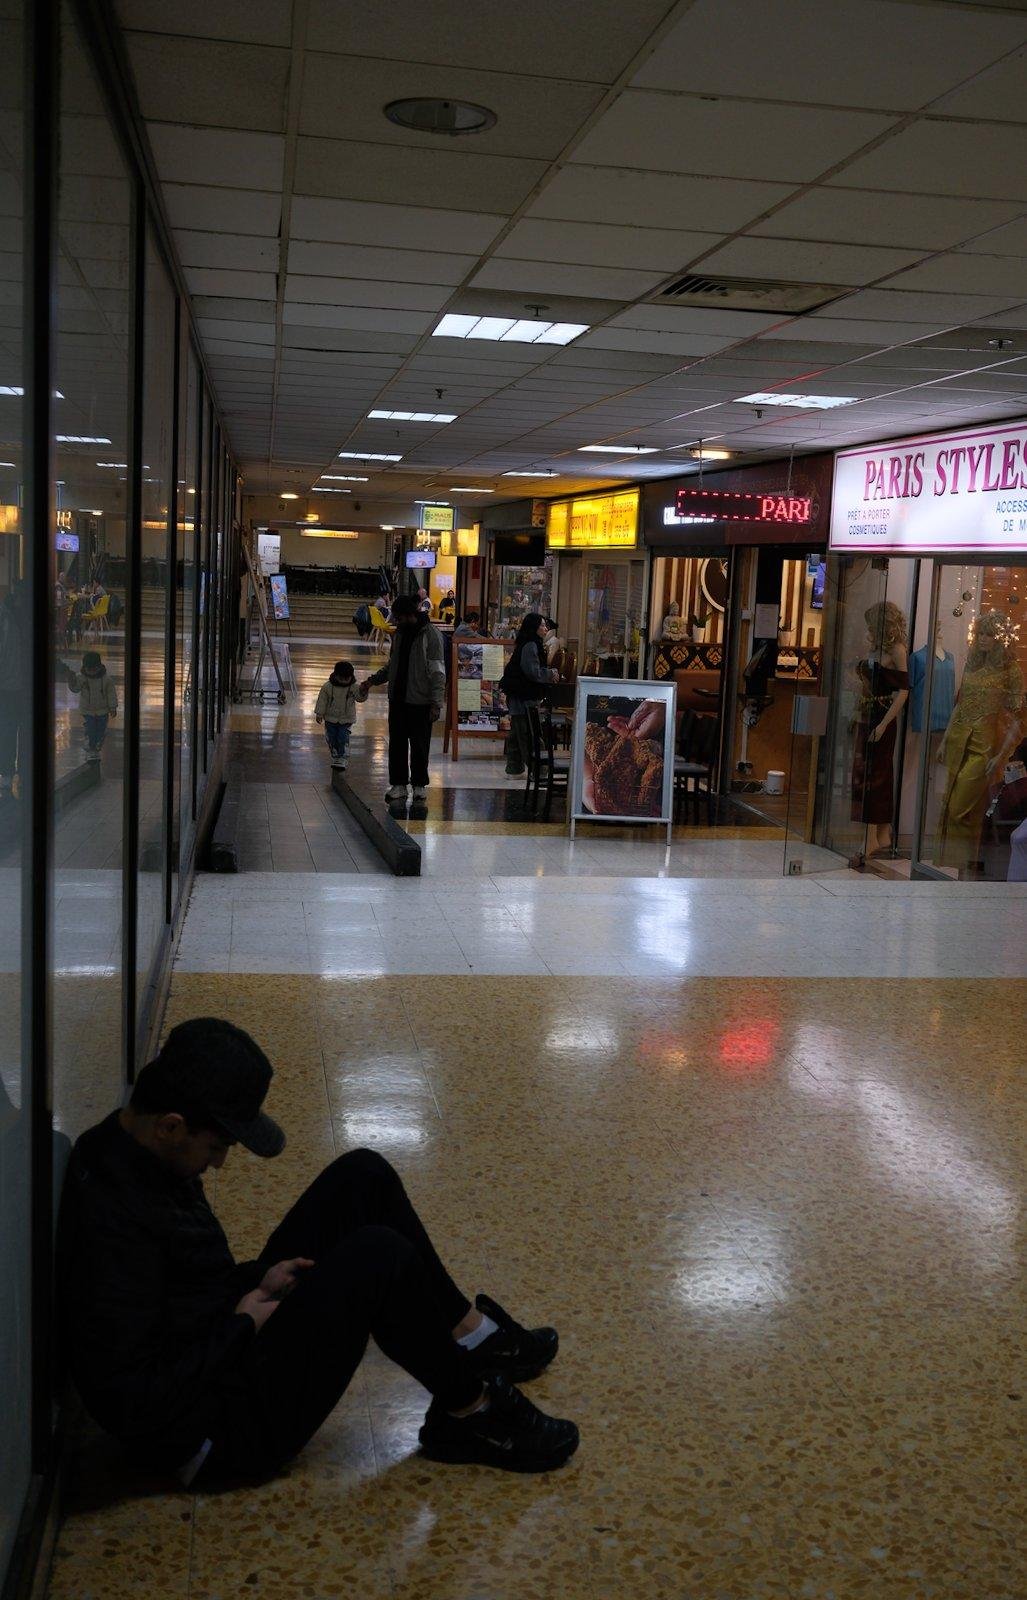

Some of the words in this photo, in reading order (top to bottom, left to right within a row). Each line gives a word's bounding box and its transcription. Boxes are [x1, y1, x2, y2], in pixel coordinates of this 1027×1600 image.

[863, 451, 925, 501] PARIS
[761, 498, 810, 521] PARI
[868, 508, 890, 520] PORTER
[848, 523, 888, 535] COSMETIQUES
[1003, 519, 1014, 531] DE
[1019, 519, 1027, 531] M
